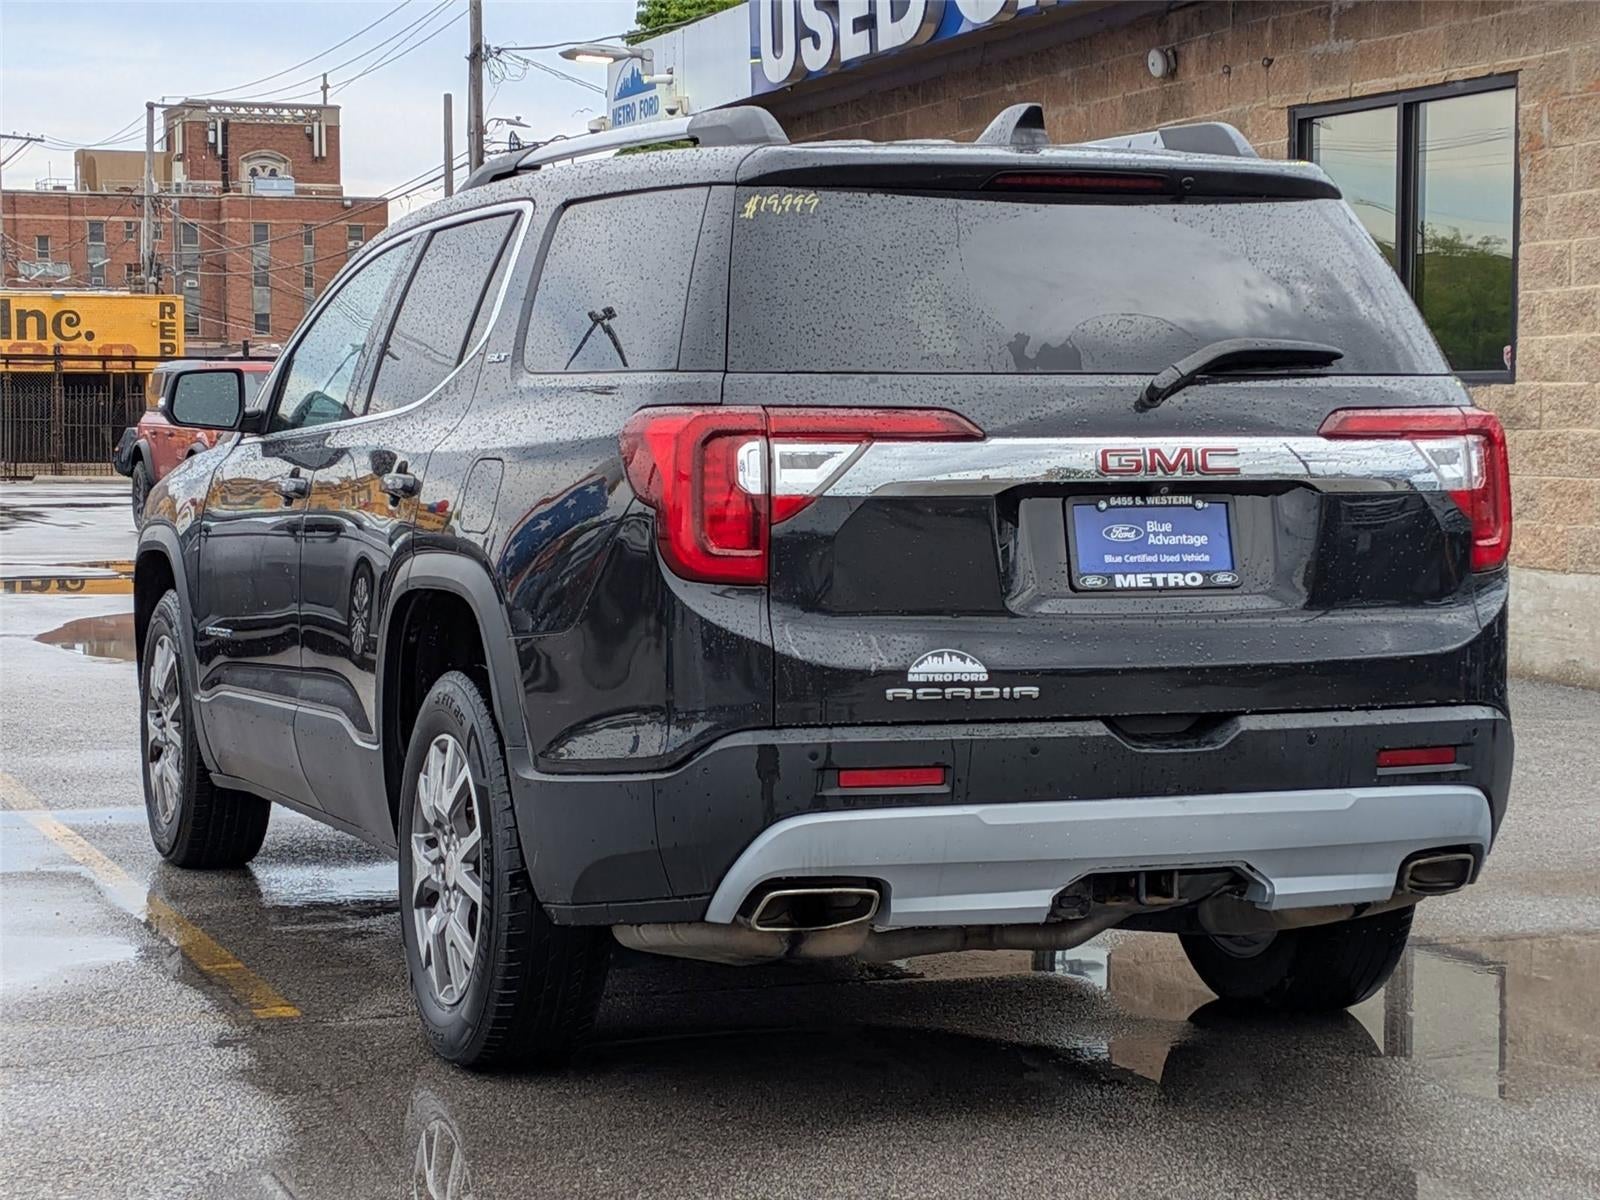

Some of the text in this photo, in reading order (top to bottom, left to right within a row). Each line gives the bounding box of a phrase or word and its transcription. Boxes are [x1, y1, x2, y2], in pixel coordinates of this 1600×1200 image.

[612, 95, 660, 128] METRO FORD
[740, 193, 820, 219] $19,999
[0, 299, 96, 342] Inc.
[1098, 447, 1241, 475] GMC
[1110, 496, 1133, 506] 6455
[1146, 495, 1193, 505] WESTERN
[1110, 526, 1137, 539] Ford
[1146, 520, 1173, 532] Blue
[1147, 533, 1209, 547] Advantage
[1104, 552, 1211, 563] Blue Certified Used Vehicle
[1114, 572, 1204, 588] METRO
[885, 686, 1040, 701] ACADIA
